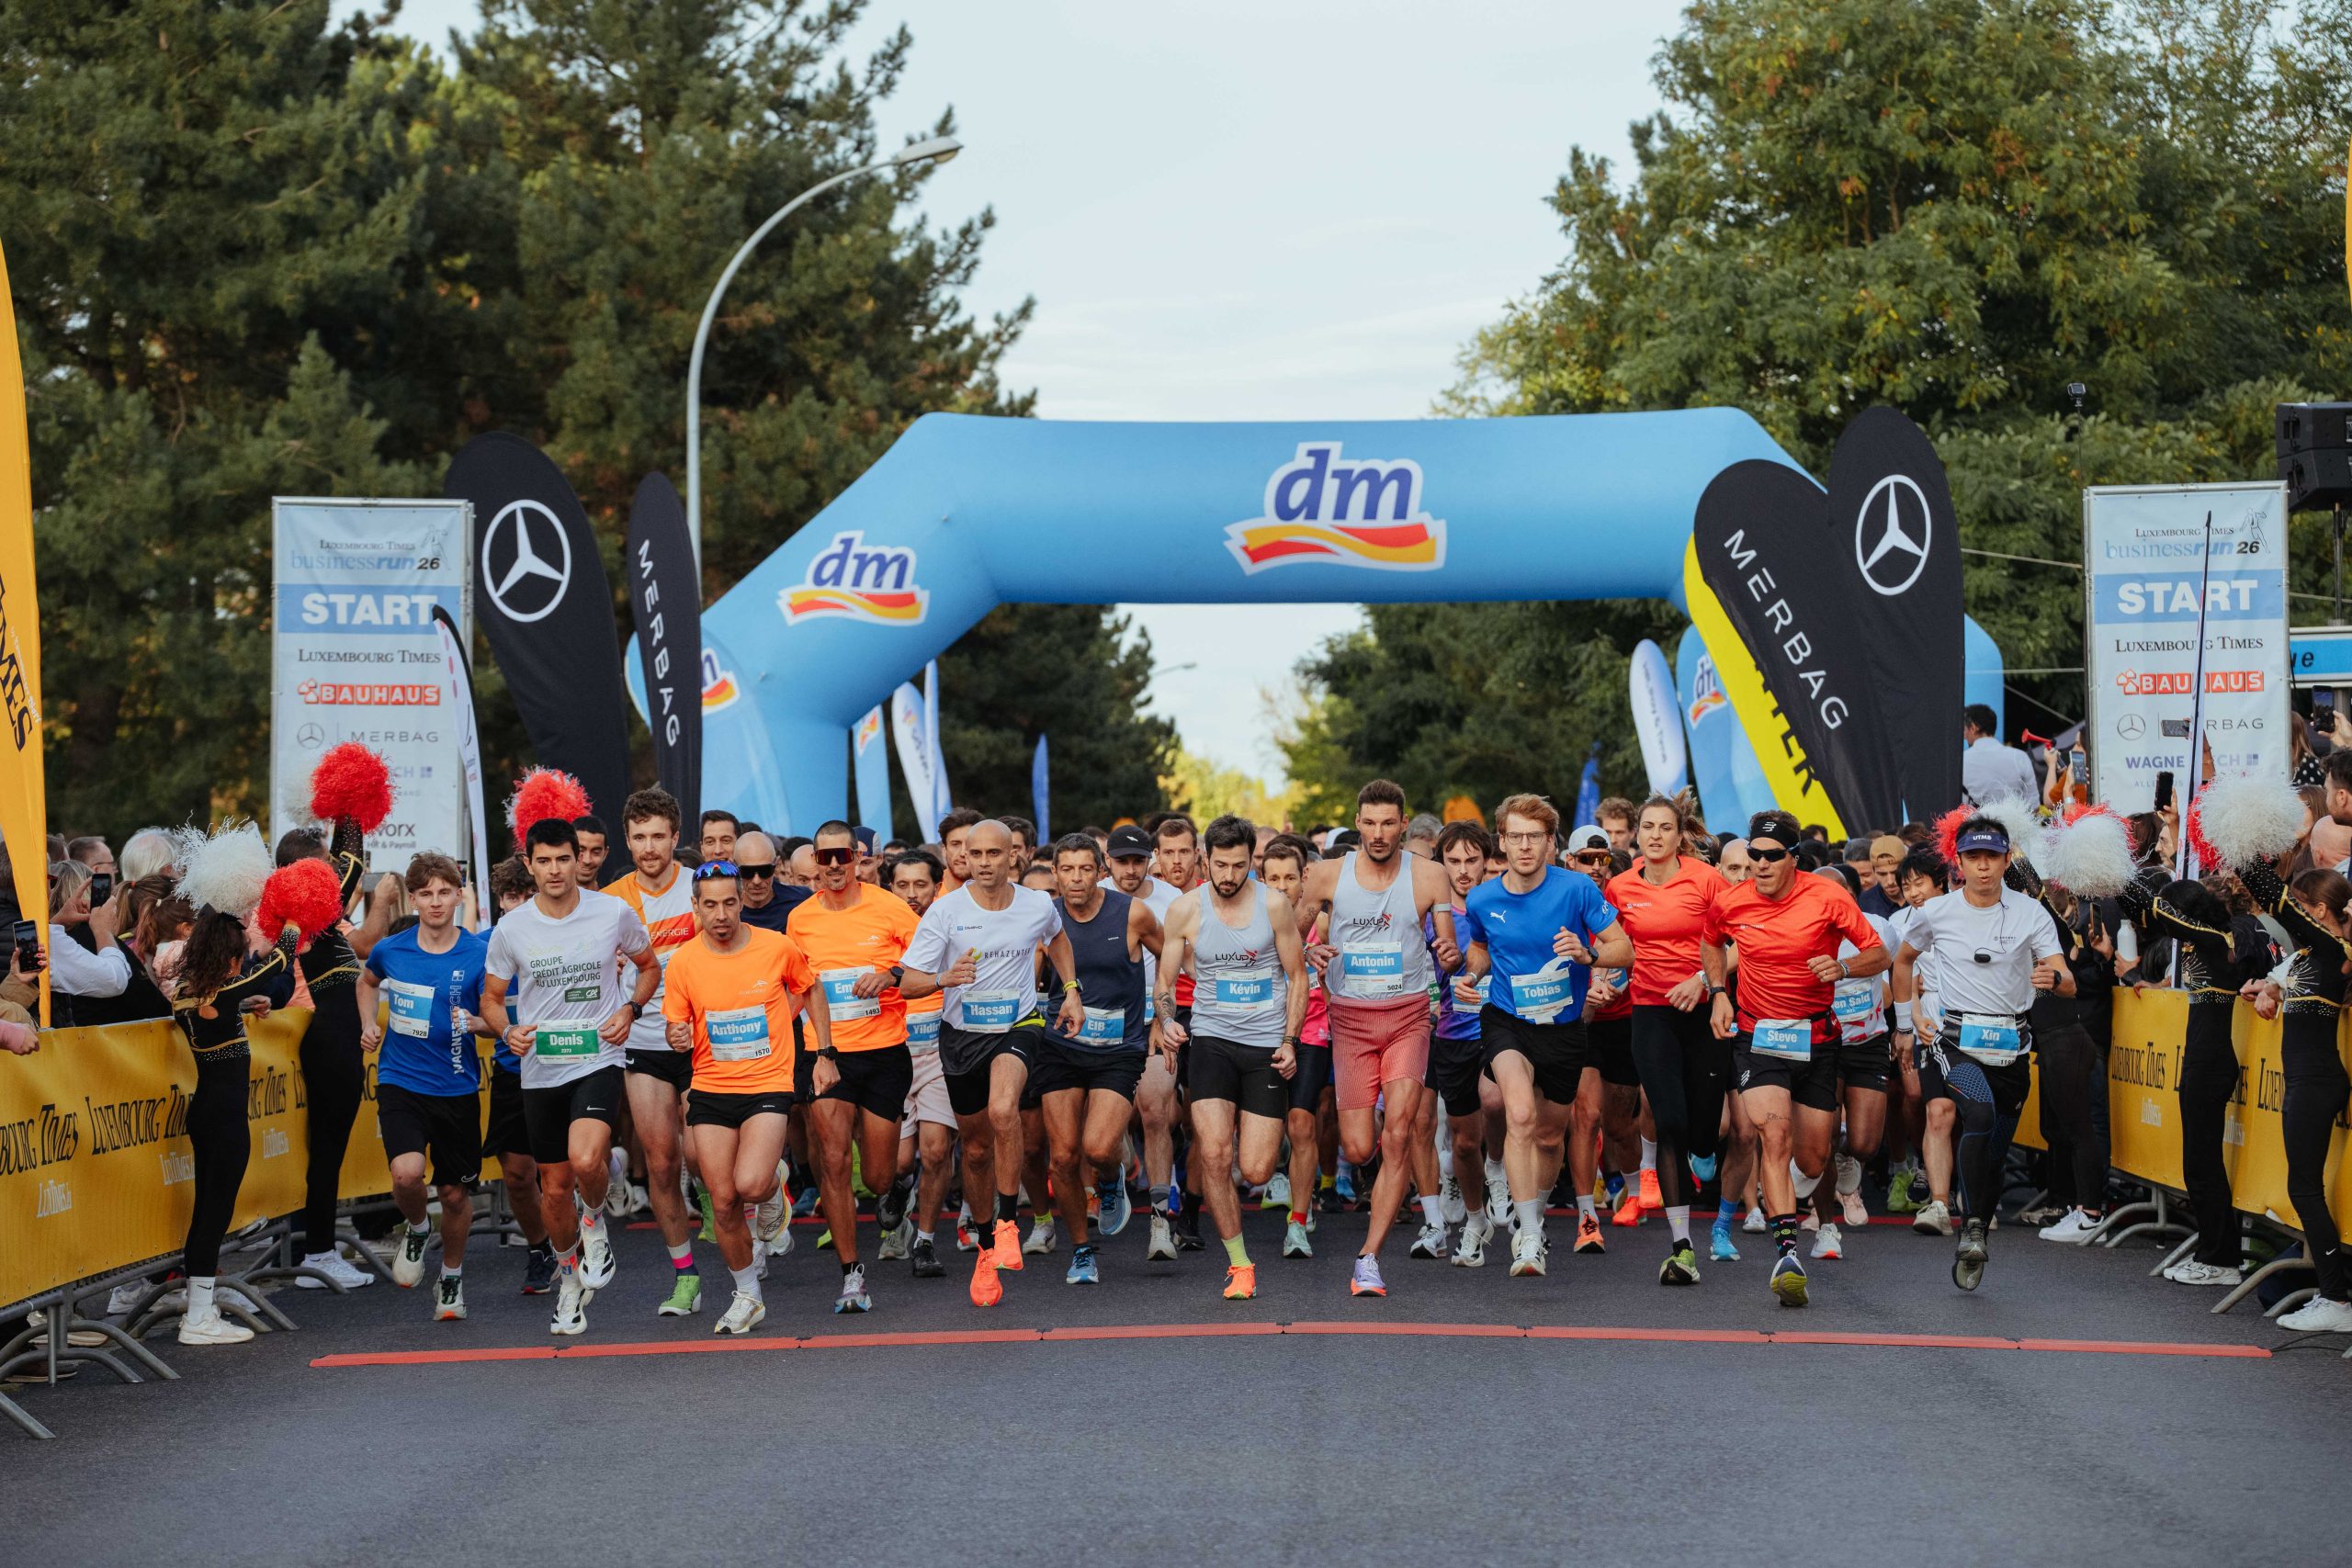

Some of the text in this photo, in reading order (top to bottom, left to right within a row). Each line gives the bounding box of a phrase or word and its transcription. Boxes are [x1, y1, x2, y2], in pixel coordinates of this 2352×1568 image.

[1274, 448, 1413, 521] dm
[2135, 528, 2201, 537] LUXEMBOURG
[320, 539, 416, 551] LUXEMBOURG TIMES
[2236, 541, 2261, 554] 26
[417, 558, 440, 570] 26
[812, 536, 910, 589] dm
[2117, 580, 2258, 615] START
[301, 592, 438, 626] START
[1724, 528, 1849, 730] MERBAG
[638, 538, 680, 747] MERBAG
[2115, 636, 2264, 653] LUXEMBOUG TIMES
[299, 649, 441, 663] LUXEMBOURG TIMES
[2141, 671, 2264, 693] BAUAUS
[322, 684, 440, 705] BAUHAUS
[351, 731, 439, 742] MERBAG
[650, 927, 689, 940] ENERGIE
[530, 955, 563, 969] GROUPE
[1351, 955, 1395, 967] Antonin
[532, 961, 602, 979] CRÉDIT AGRICOLE
[547, 972, 601, 987] LUXEMBOURG
[1229, 983, 1261, 995] Kévin
[1522, 984, 1562, 998] Tobias
[393, 993, 414, 1010] Tom
[865, 1008, 880, 1016] 1493
[969, 1004, 1013, 1016] Hassan
[412, 1029, 427, 1037] 7928
[711, 1021, 762, 1036] Anthony
[1087, 1020, 1105, 1032] EIB
[548, 1033, 583, 1046] Denis
[1767, 1030, 1798, 1043] Steve
[1981, 1029, 2000, 1041] Xin
[754, 1047, 770, 1057] 1570
[2146, 1041, 2166, 1090] TIMES
[39, 1103, 79, 1166] TIMES
[85, 1096, 167, 1156] LUXEMBOURG
